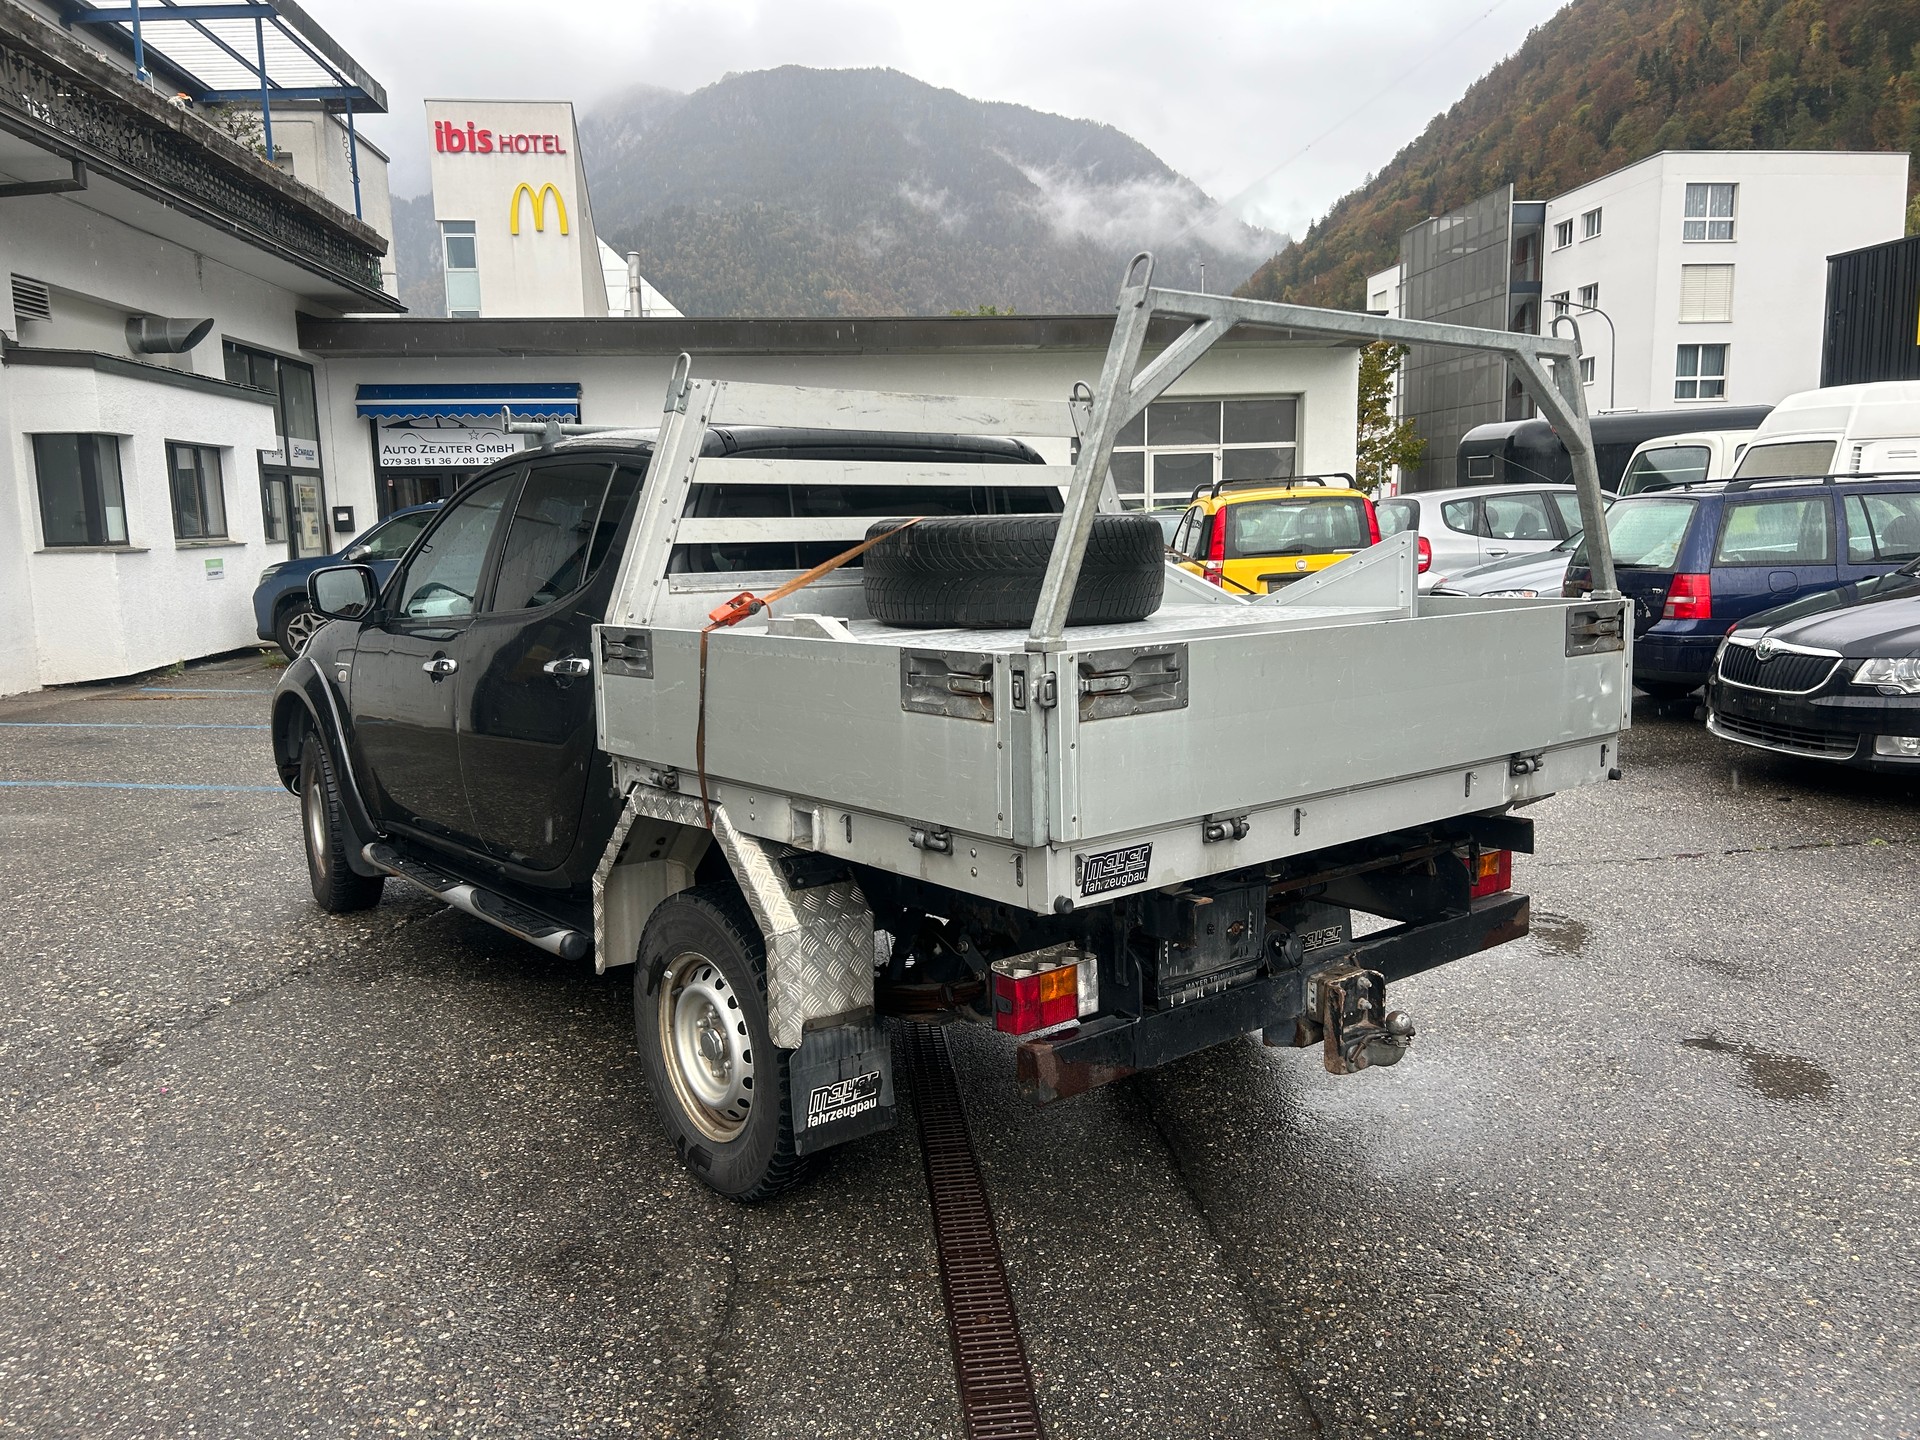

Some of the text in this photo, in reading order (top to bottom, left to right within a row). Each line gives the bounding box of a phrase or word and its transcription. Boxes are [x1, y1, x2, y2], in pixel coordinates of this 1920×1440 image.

[434, 120, 567, 154] ibis HOTEL
[382, 457, 402, 466] 079
[404, 457, 421, 466] 381
[424, 457, 435, 466] 51
[438, 457, 452, 465] 36
[462, 457, 479, 465] 081
[807, 1097, 877, 1128] fahrzeugbau
